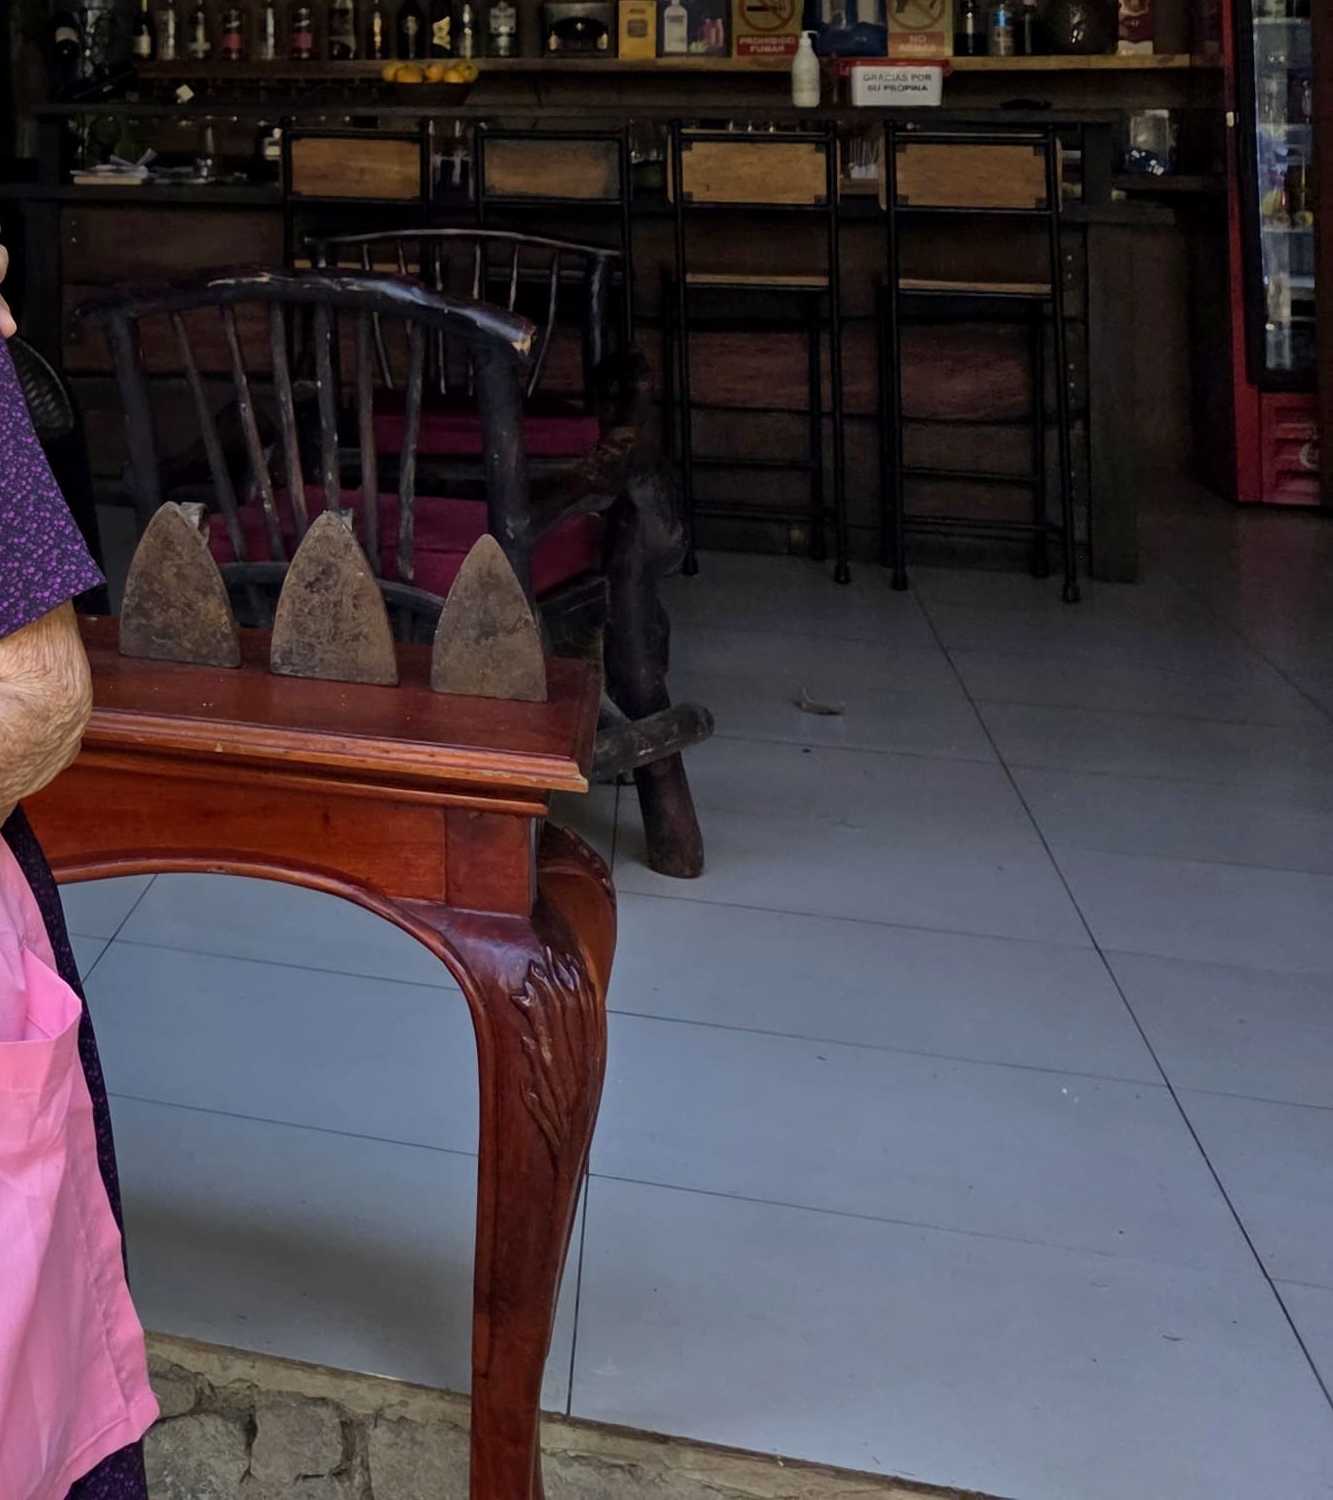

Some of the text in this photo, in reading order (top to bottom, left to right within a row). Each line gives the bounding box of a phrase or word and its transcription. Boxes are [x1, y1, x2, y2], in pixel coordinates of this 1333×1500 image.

[909, 35, 927, 43] NO
[750, 45, 786, 53] FUMAR
[862, 74, 908, 82] GRACIAS
[867, 84, 928, 92] SU PROPINA
